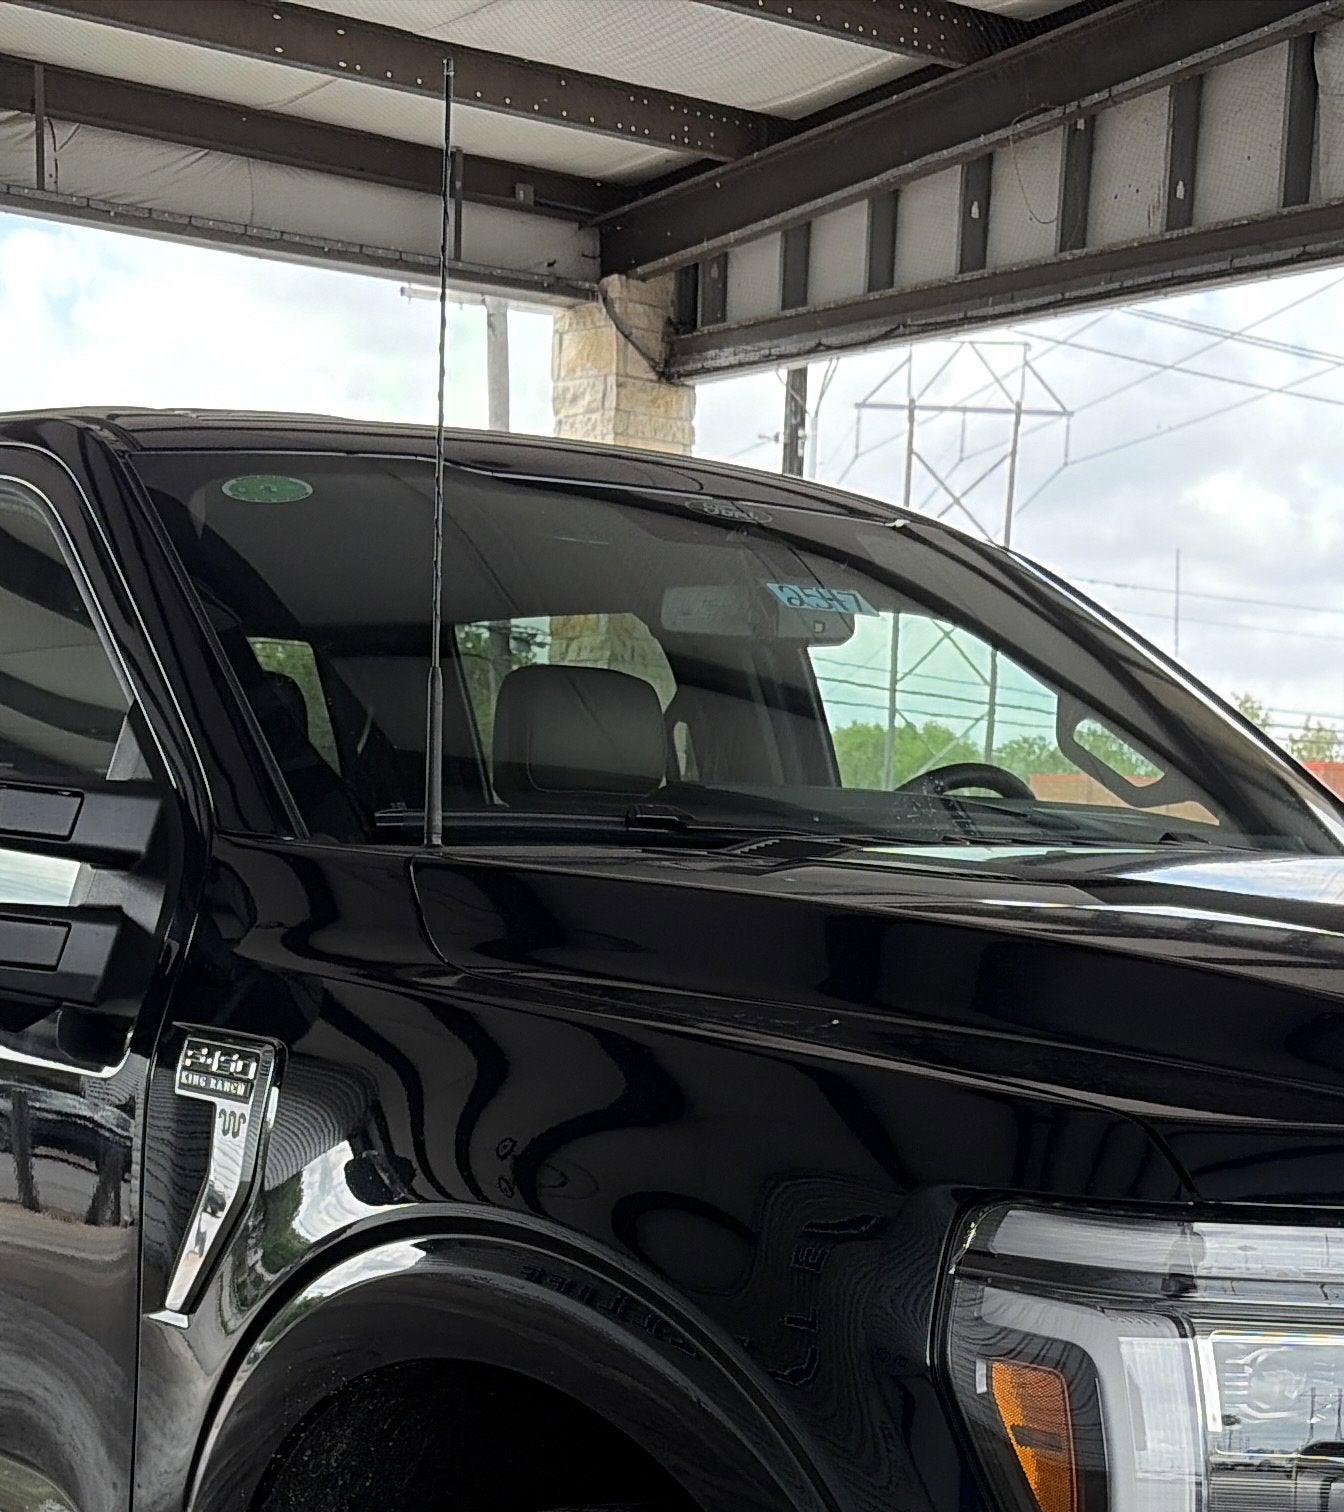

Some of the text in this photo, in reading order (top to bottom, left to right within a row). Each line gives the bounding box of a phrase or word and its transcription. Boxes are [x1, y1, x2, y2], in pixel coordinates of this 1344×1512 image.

[778, 585, 862, 612] 2547
[180, 1070, 246, 1097] KING RANCH
